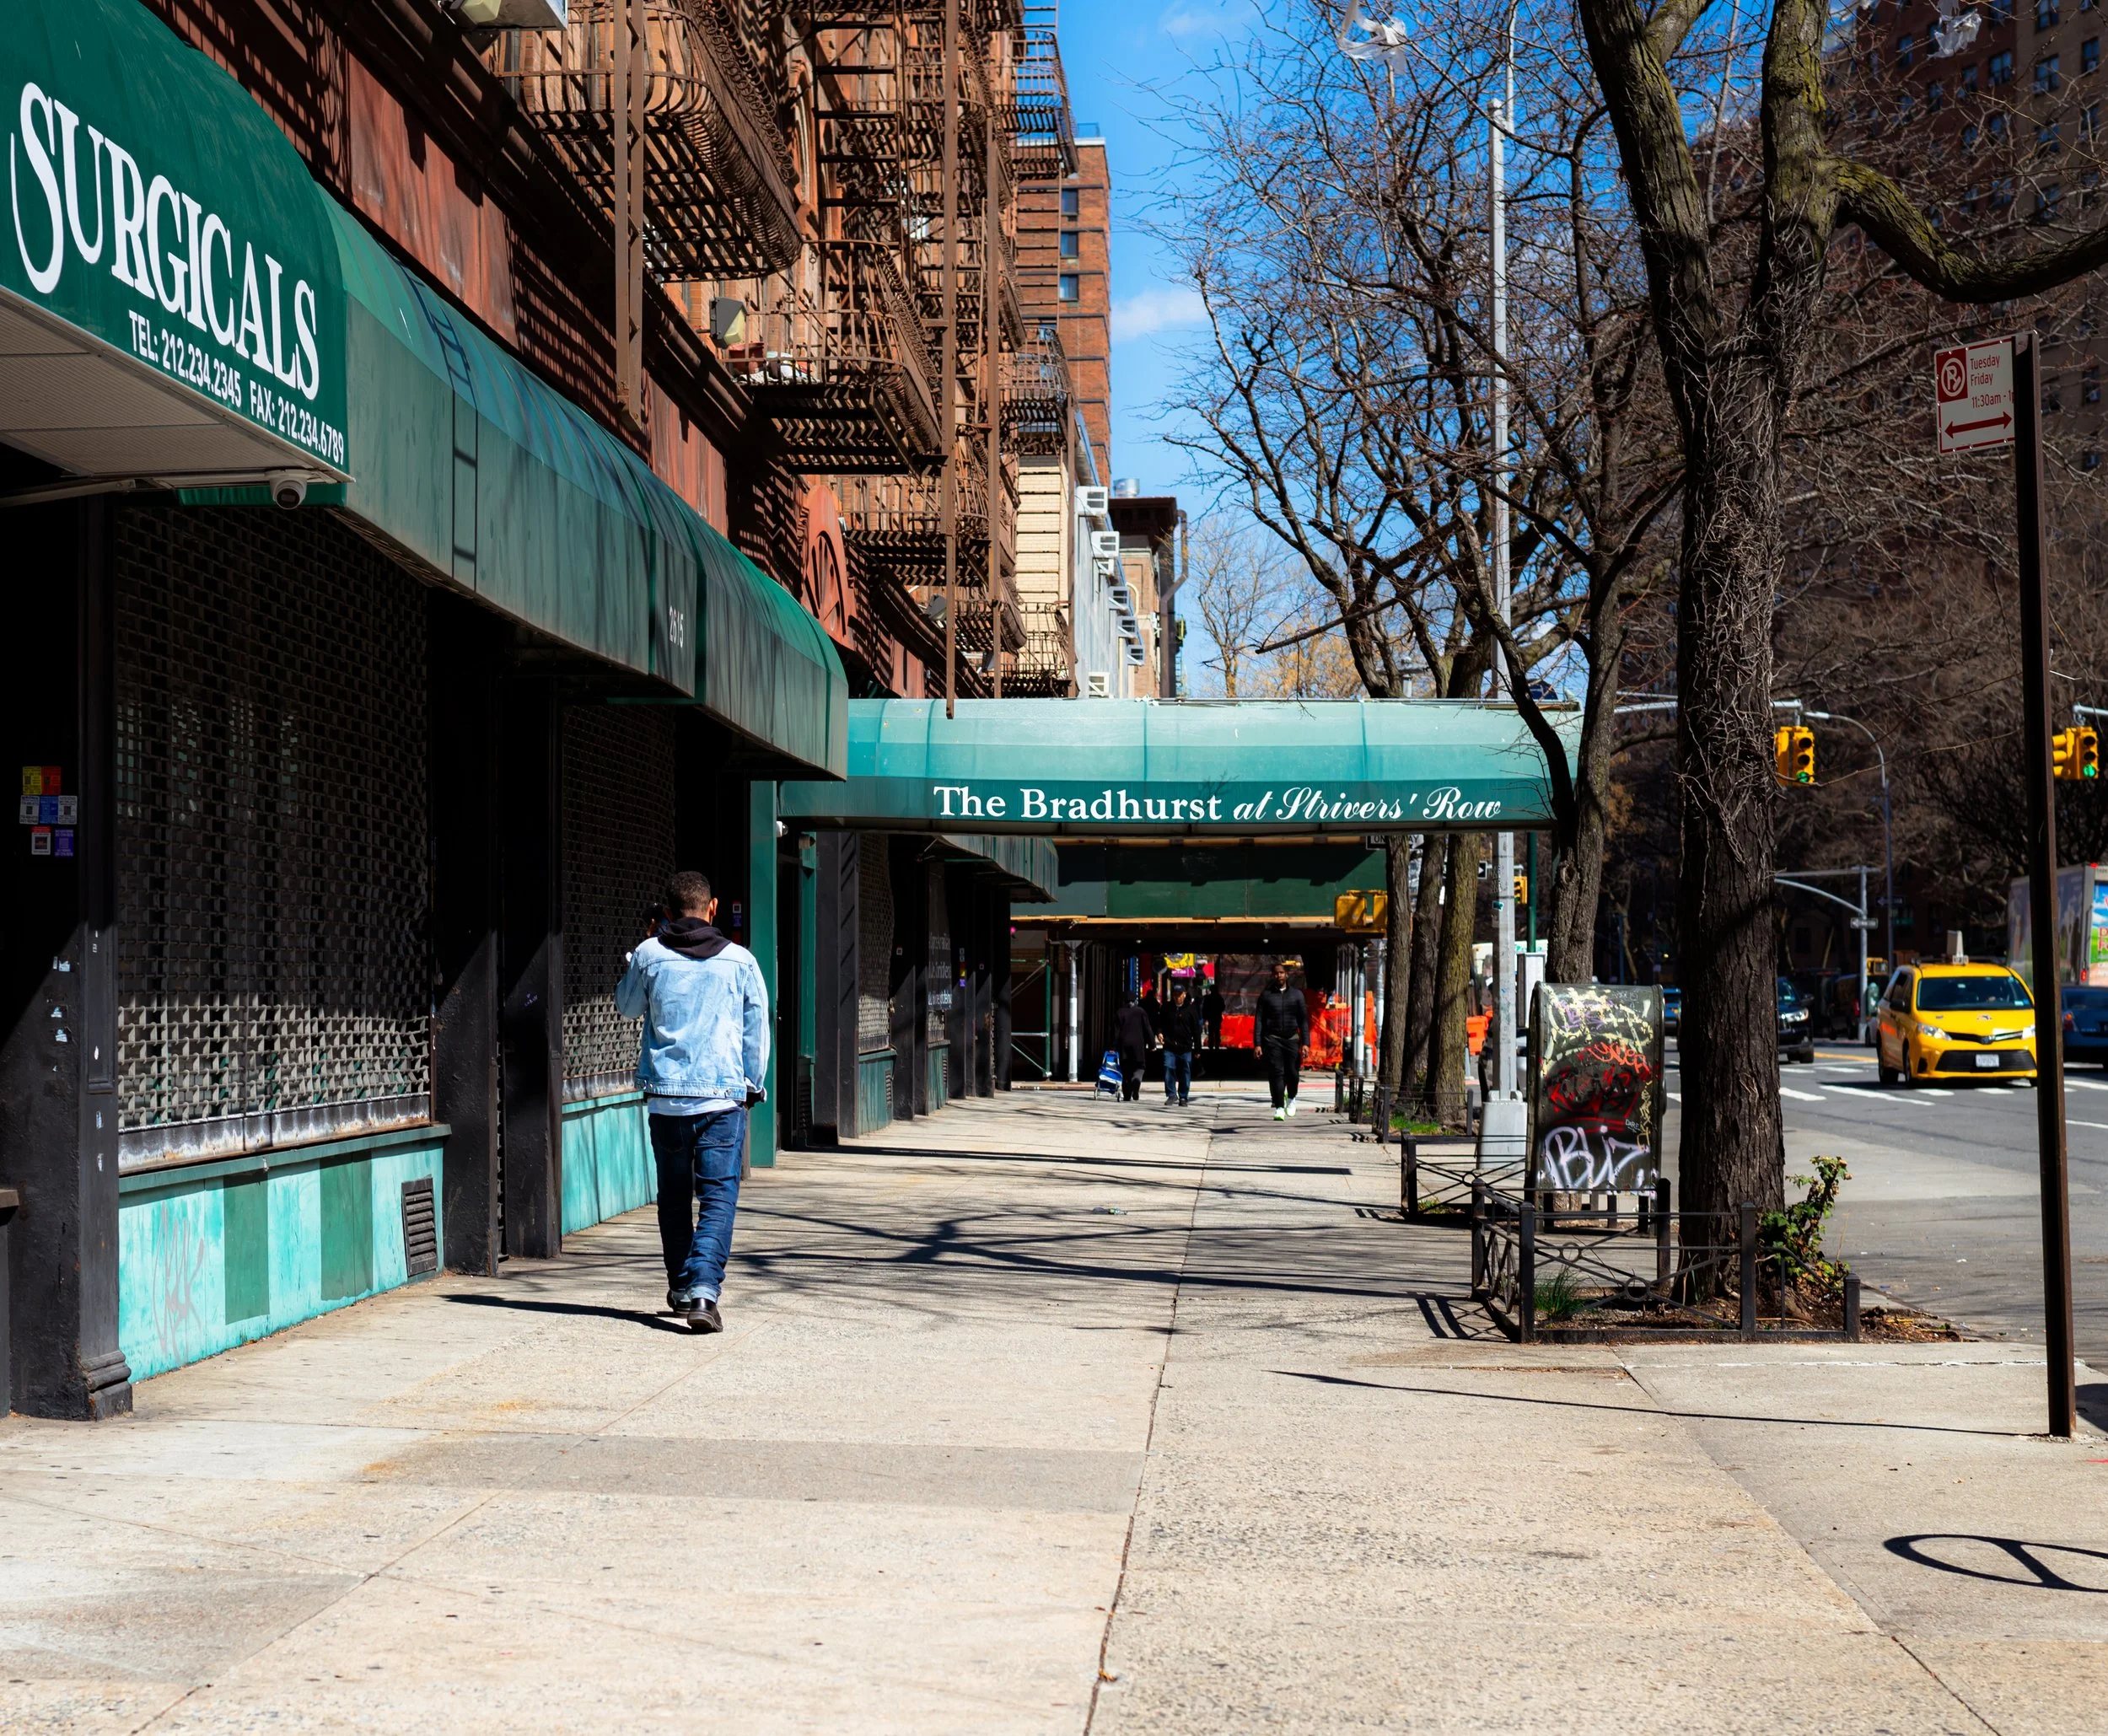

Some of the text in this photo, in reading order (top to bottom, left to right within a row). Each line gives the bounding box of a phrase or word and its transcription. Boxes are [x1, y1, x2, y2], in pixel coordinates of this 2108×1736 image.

[11, 82, 320, 400] SURGICALS
[1970, 355, 2000, 370] Tuesday
[129, 309, 344, 465] TEL: 212.234.2345 FAX: 212.234.6789
[1971, 373, 1993, 387] Friday
[1971, 394, 2002, 408] 11:30am
[669, 605, 684, 648] 2615
[933, 786, 1501, 820] The Bradhurst at Strivers' Row
